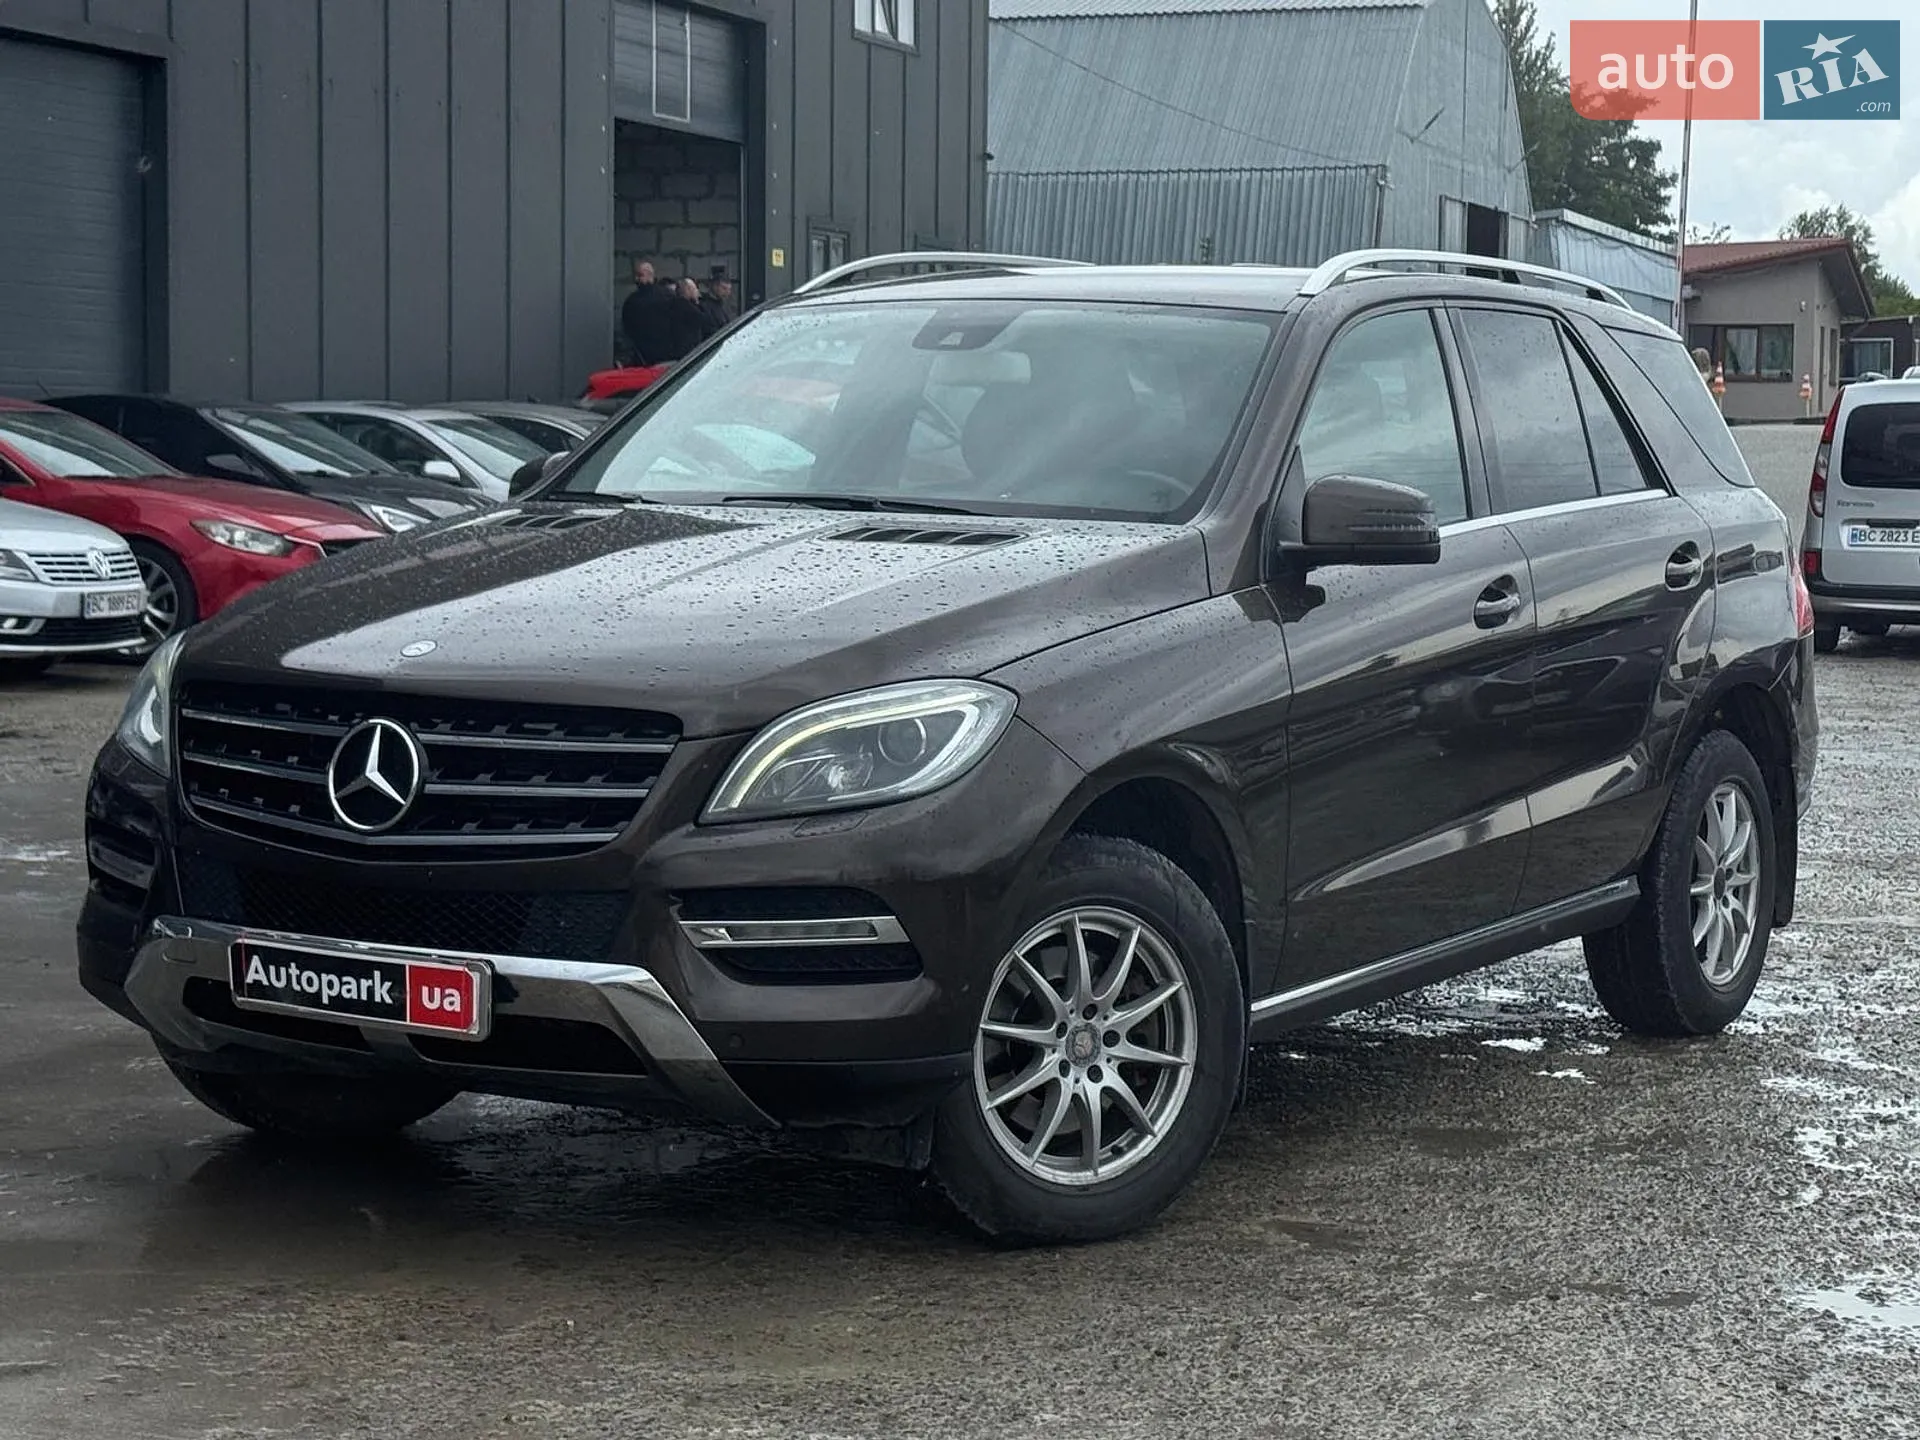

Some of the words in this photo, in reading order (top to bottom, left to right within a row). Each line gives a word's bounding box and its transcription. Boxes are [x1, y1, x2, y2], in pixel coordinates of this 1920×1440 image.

[1858, 530, 1877, 543] BC
[1880, 530, 1909, 543] 2823
[246, 954, 393, 1005] Autopark
[421, 985, 462, 1012] ua
